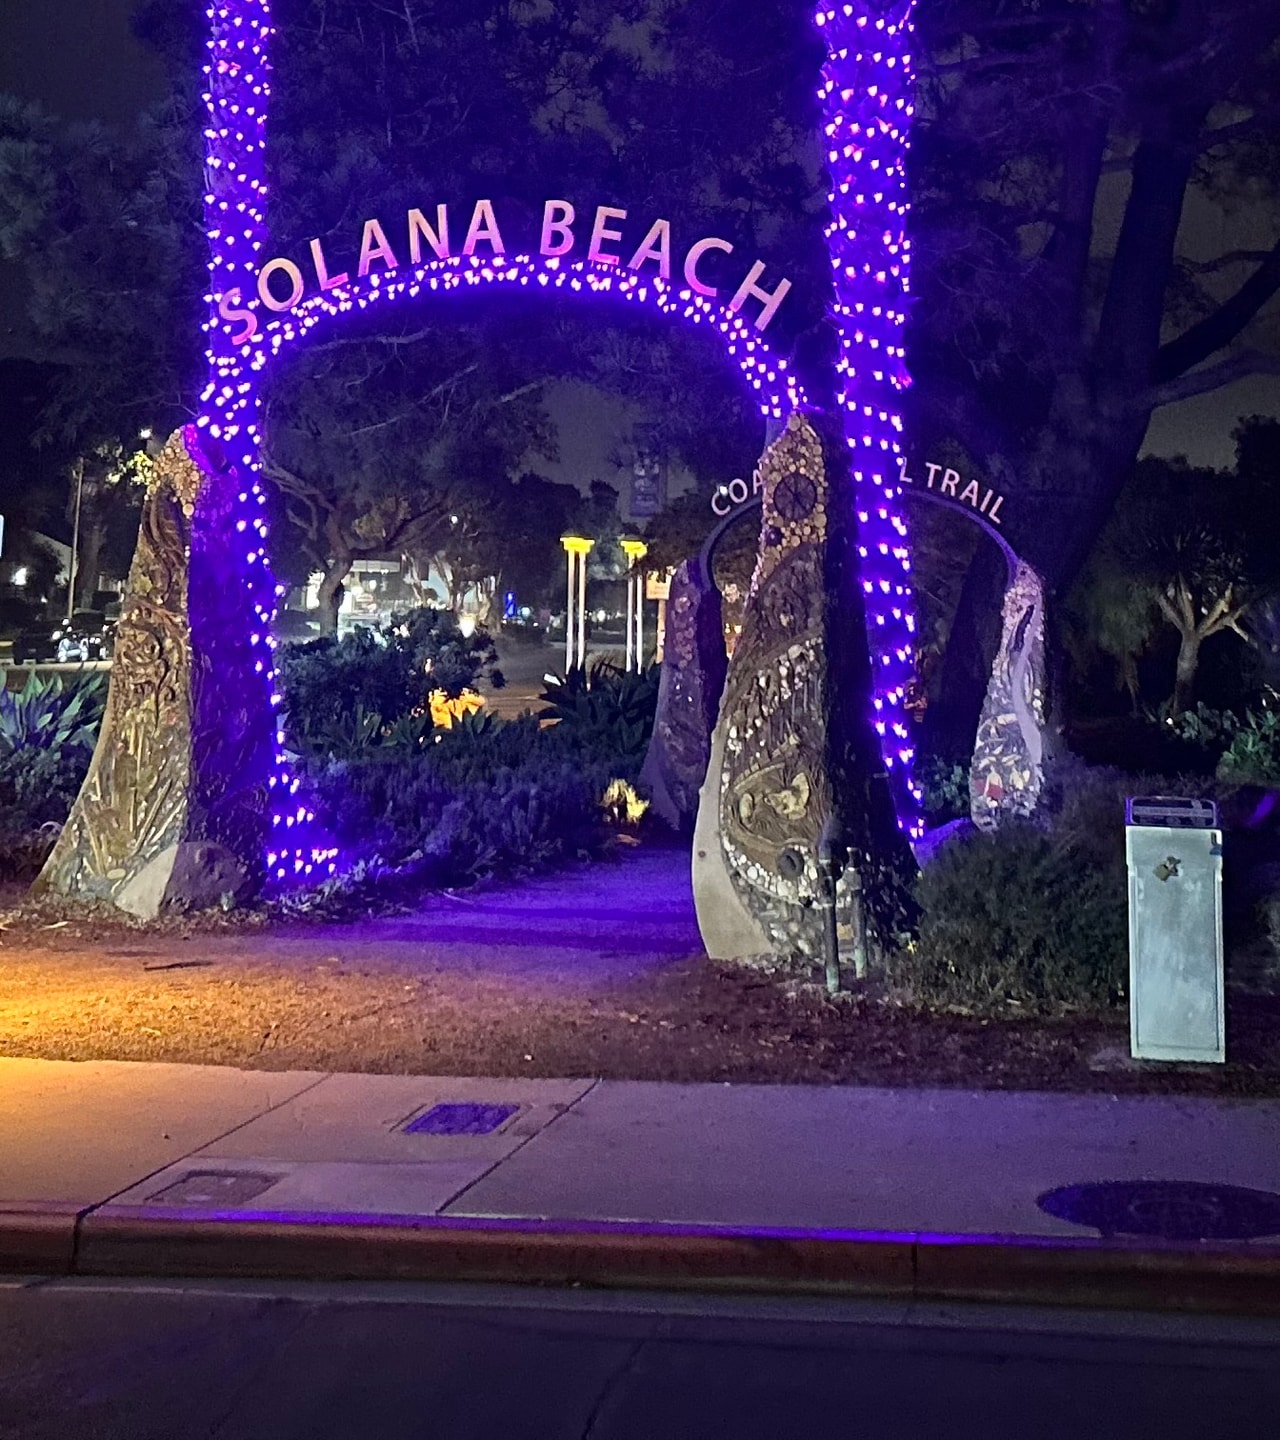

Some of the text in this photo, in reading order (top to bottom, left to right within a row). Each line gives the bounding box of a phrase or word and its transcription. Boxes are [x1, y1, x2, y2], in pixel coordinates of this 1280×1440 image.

[218, 199, 792, 346] SOLANA BEACH
[925, 461, 1005, 525] TRAIL
